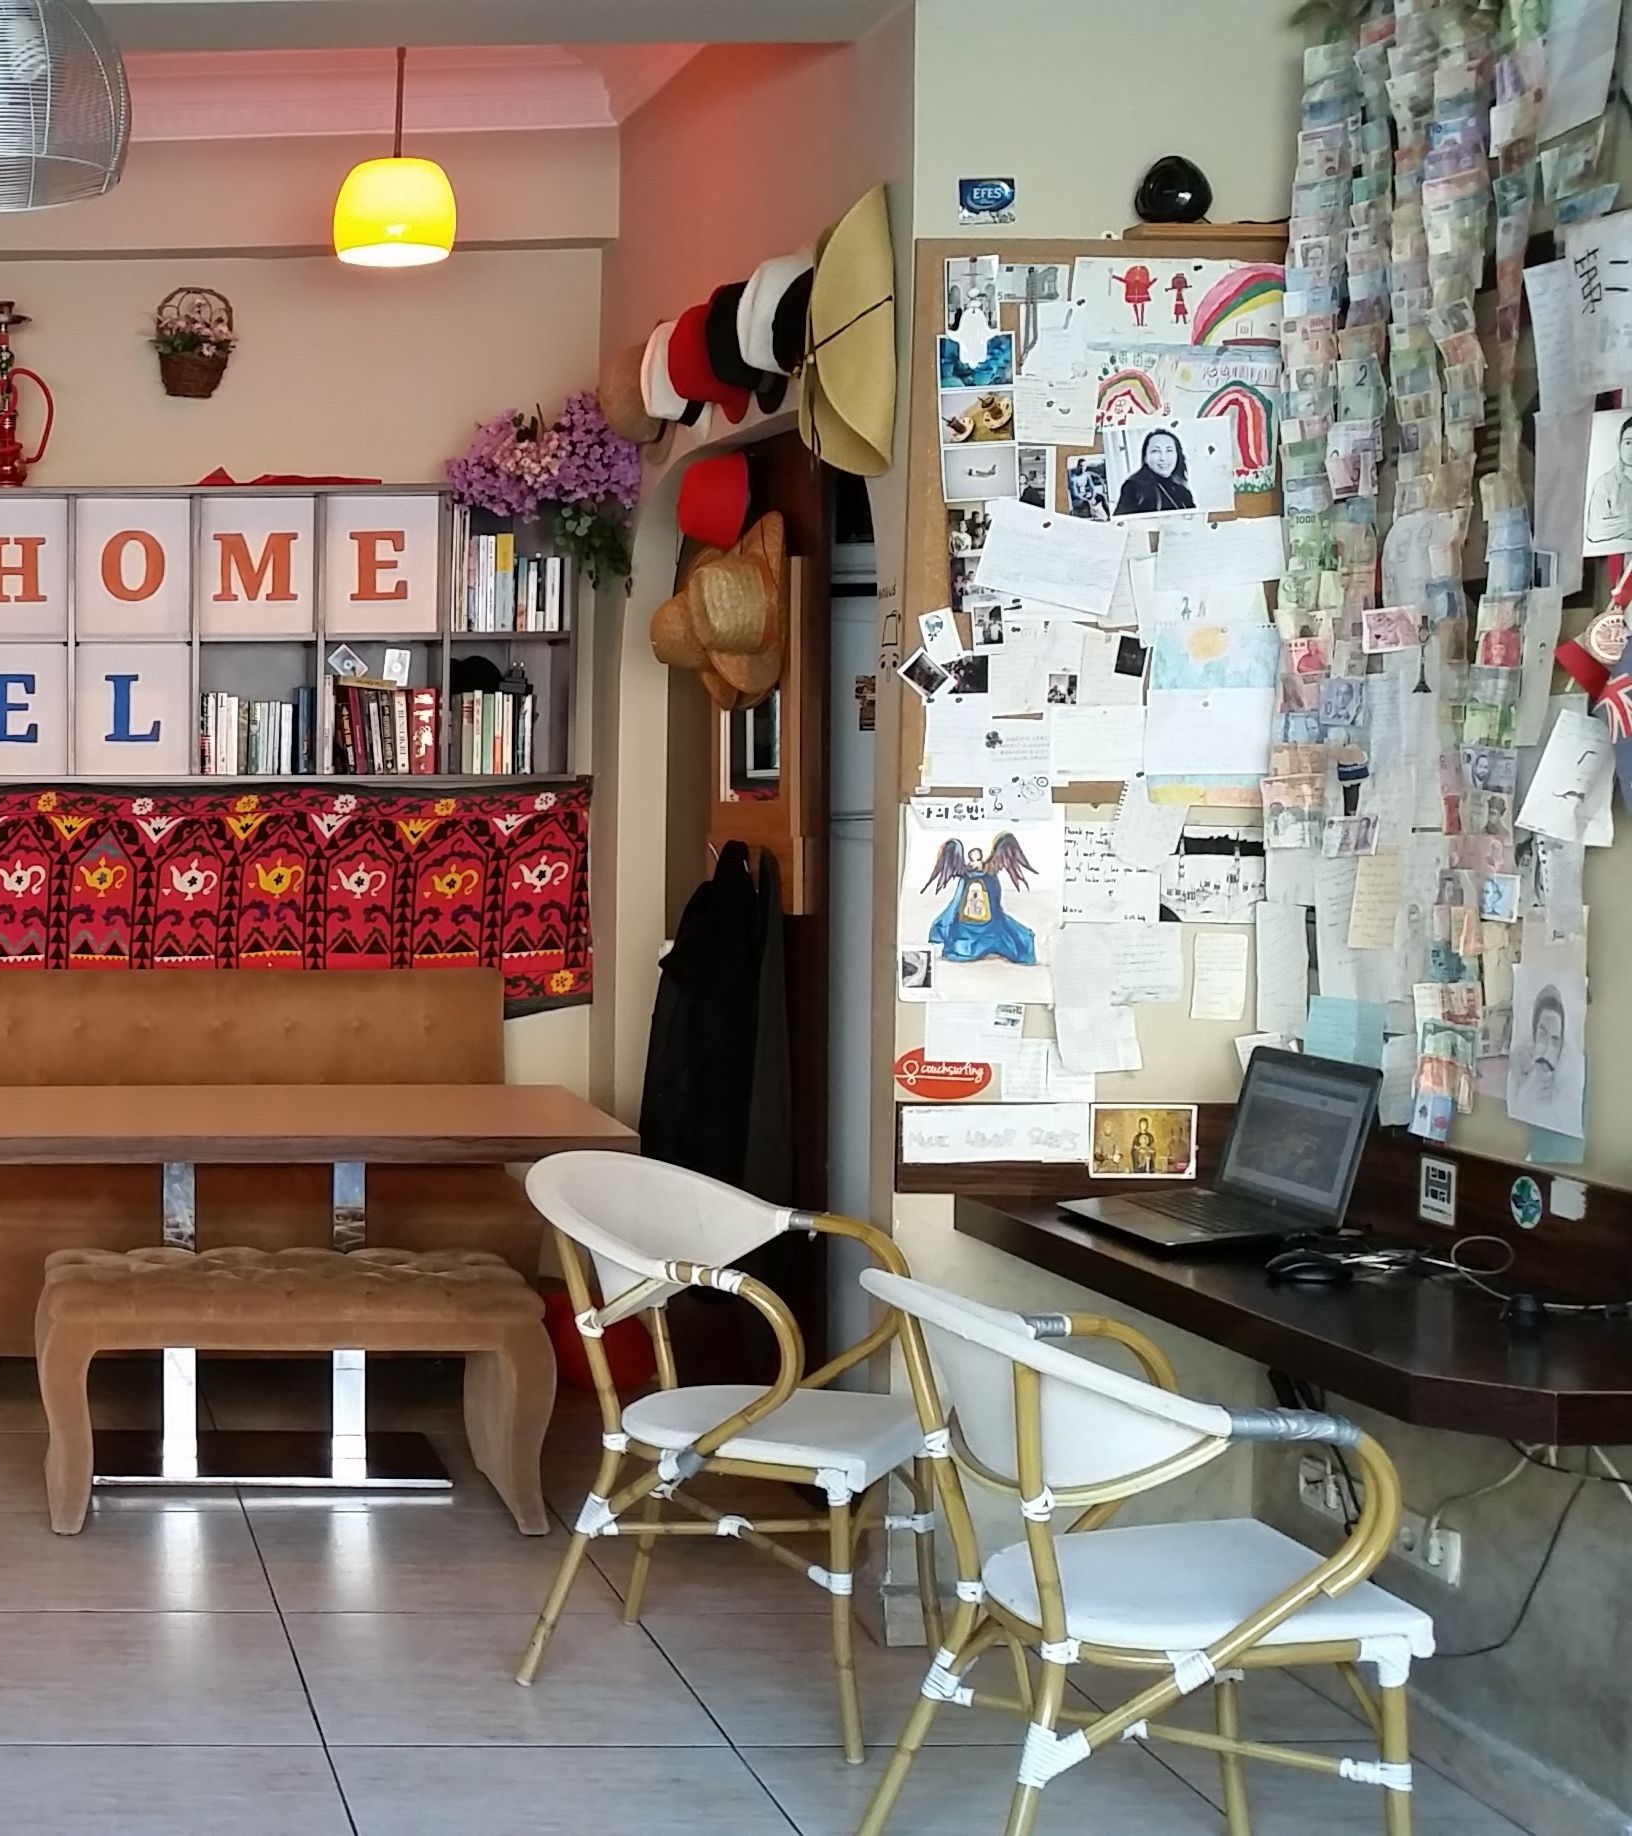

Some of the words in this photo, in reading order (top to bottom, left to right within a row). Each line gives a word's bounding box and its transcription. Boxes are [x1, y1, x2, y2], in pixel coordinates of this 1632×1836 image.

[973, 187, 1002, 200] EFES
[1295, 515, 1316, 524] 1000
[920, 1061, 984, 1084] couchsurfing
